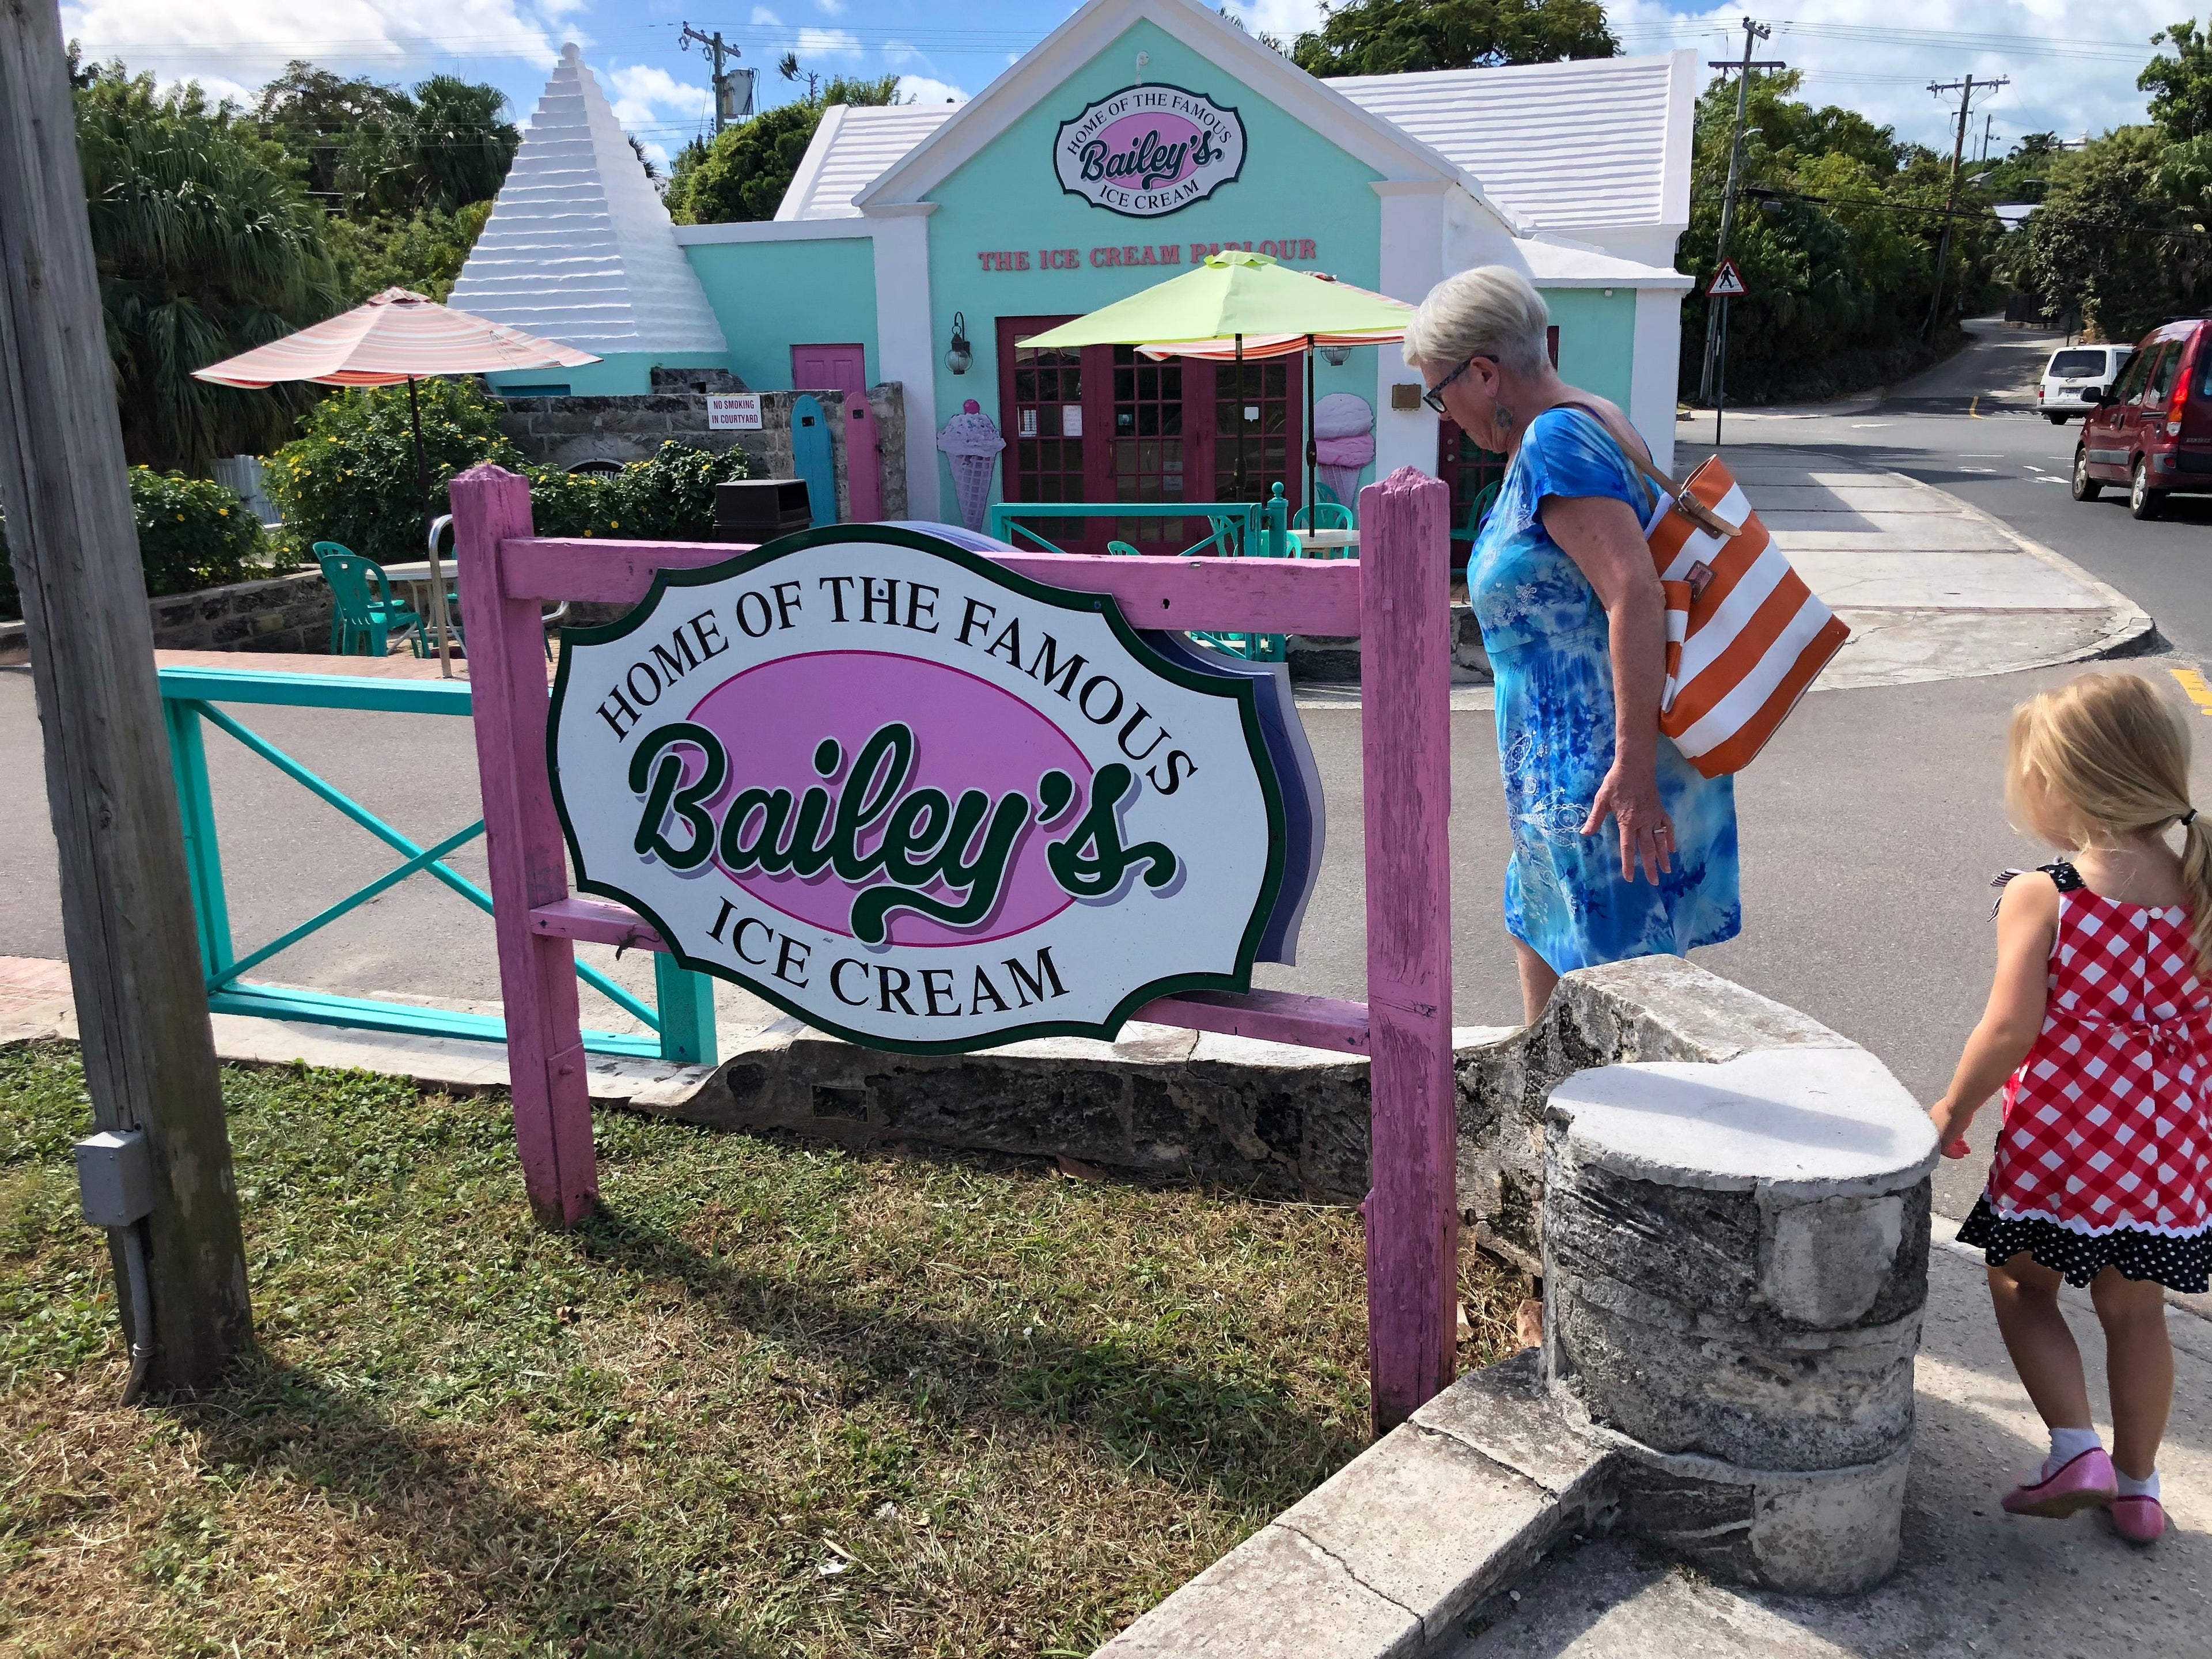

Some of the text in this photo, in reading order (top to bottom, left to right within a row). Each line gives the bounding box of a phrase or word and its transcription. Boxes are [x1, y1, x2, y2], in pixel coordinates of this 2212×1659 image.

[1067, 93, 1232, 156] HOME OF THE FAMOUS
[1079, 130, 1223, 191] Bailey's
[1099, 179, 1199, 209] ICE CREAM
[978, 251, 1030, 271] THE
[1039, 249, 1081, 270] ICE
[1089, 244, 1180, 268] CREAM
[711, 414, 758, 423] IN COURTYARD
[713, 400, 755, 410] NO SMOKING
[595, 576, 1199, 796] HOME OF THE FAMOUS
[628, 722, 1177, 946] Bailey's
[706, 896, 1071, 1017] ICE CREAM
